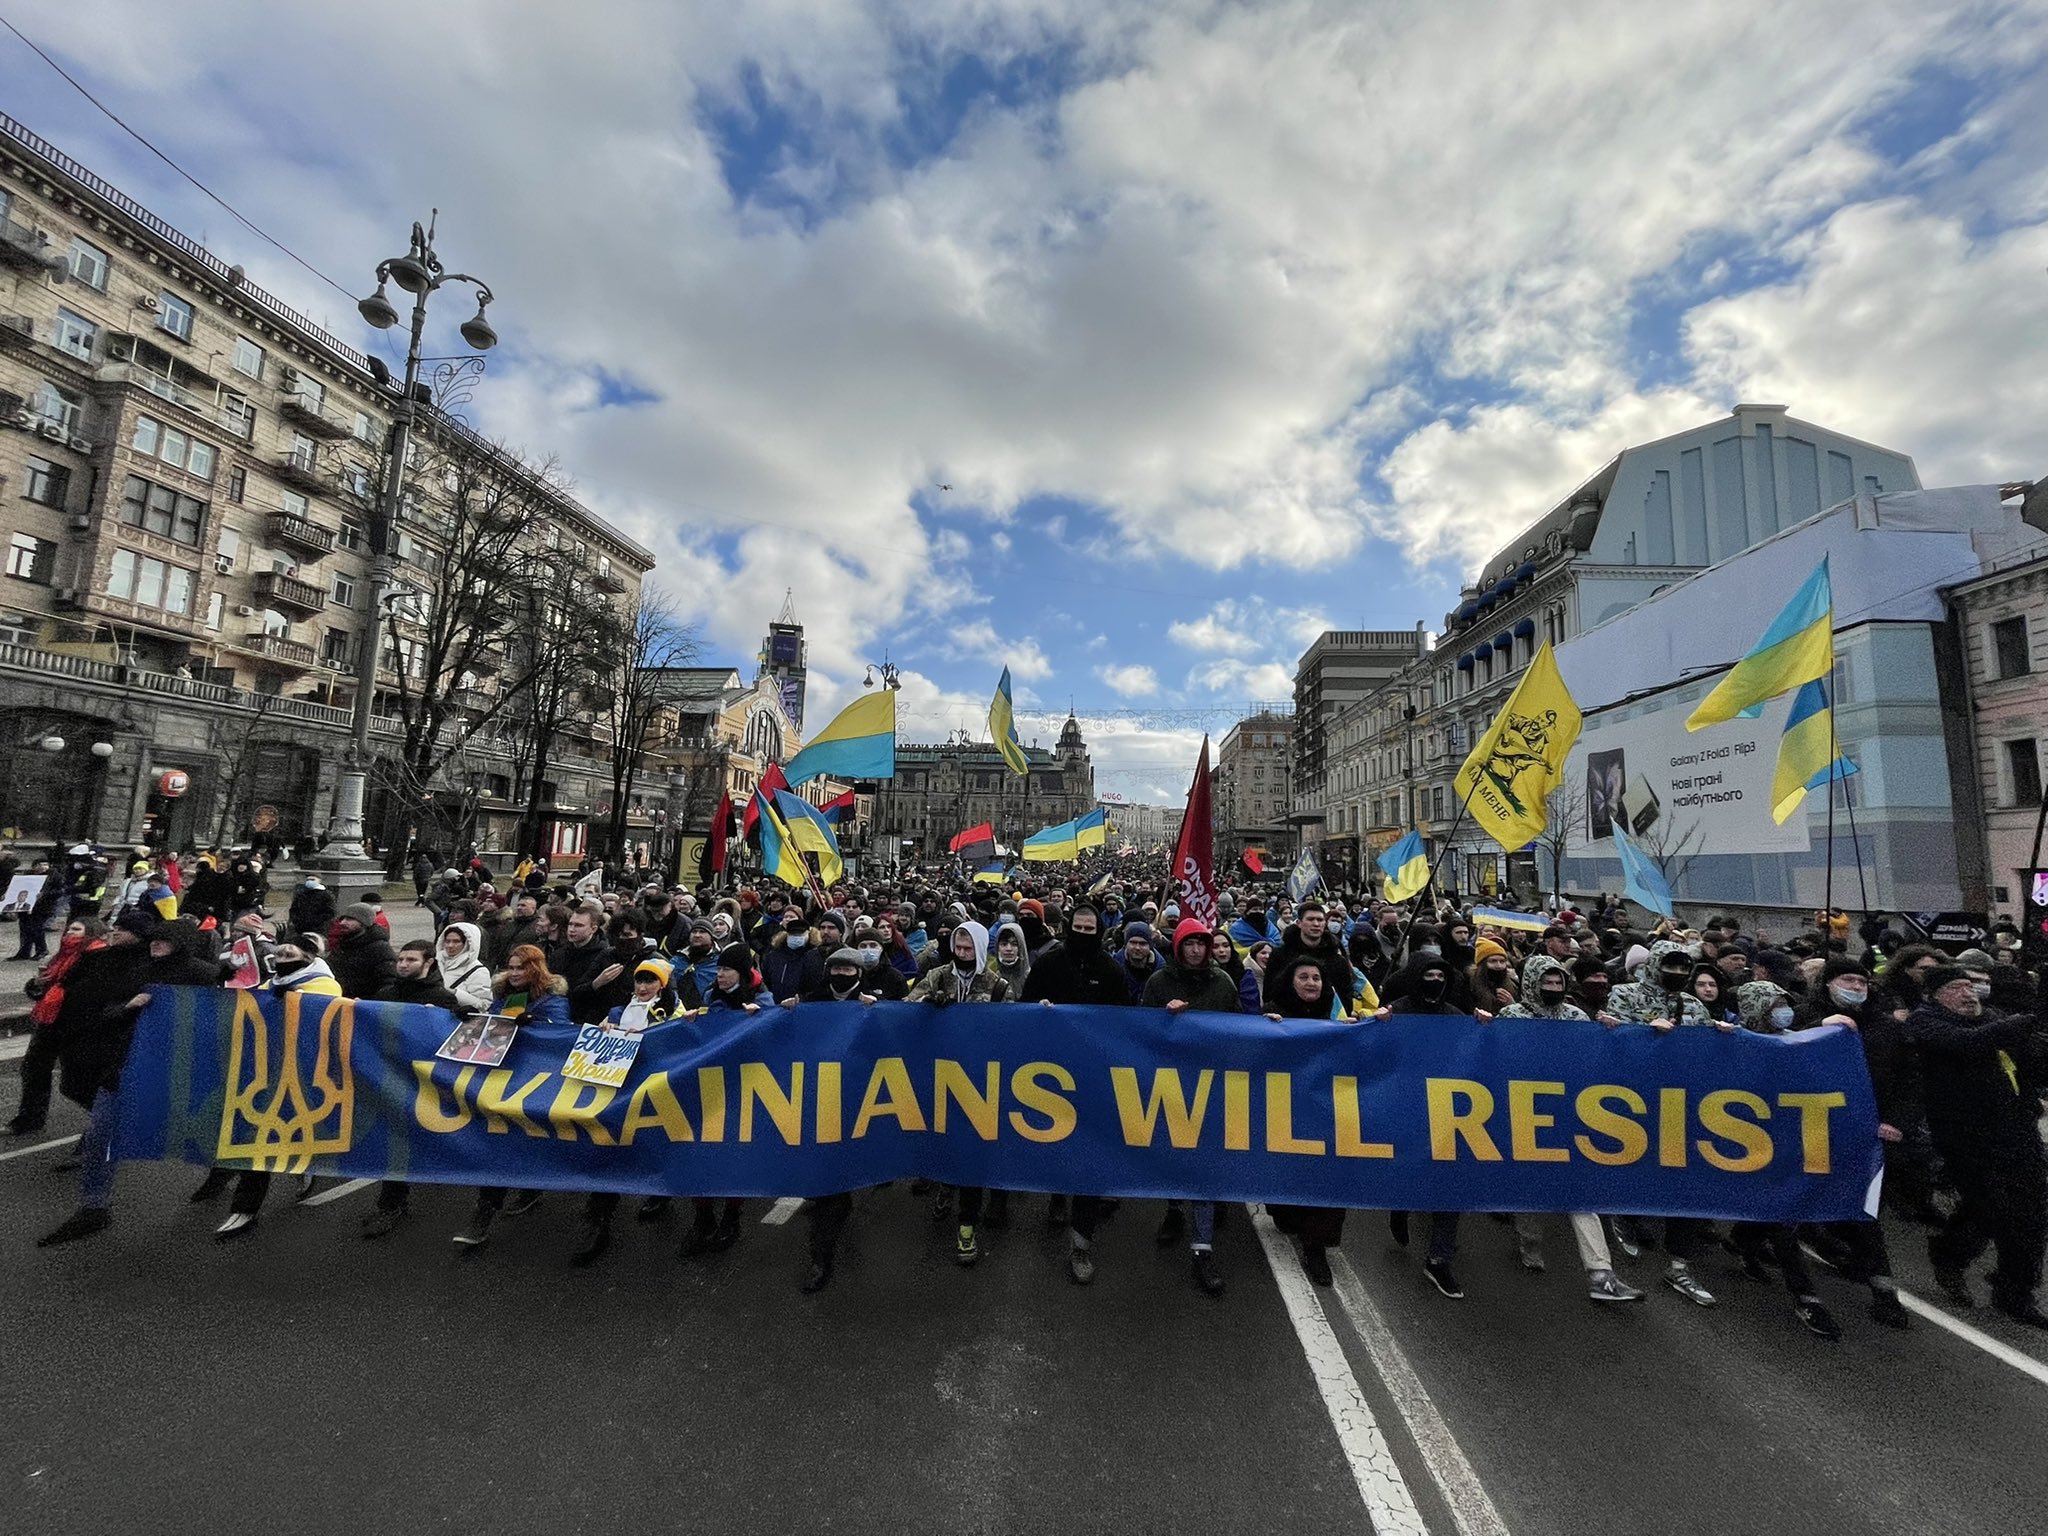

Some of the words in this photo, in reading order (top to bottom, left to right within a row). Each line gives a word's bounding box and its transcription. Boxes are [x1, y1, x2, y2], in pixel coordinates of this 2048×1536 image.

[1670, 754, 1699, 767] Galaxy
[1734, 741, 1756, 757] Flip3
[1671, 776, 1693, 790] Нові
[1694, 770, 1723, 790] грані
[1101, 791, 1122, 801] HUGO
[1479, 785, 1511, 821] МЕНЕ
[1673, 790, 1743, 808] майбутнього
[412, 1056, 1077, 1146] UKRAINIANS
[1110, 1067, 1394, 1158] WILL
[1426, 1077, 1847, 1173] RESIST
